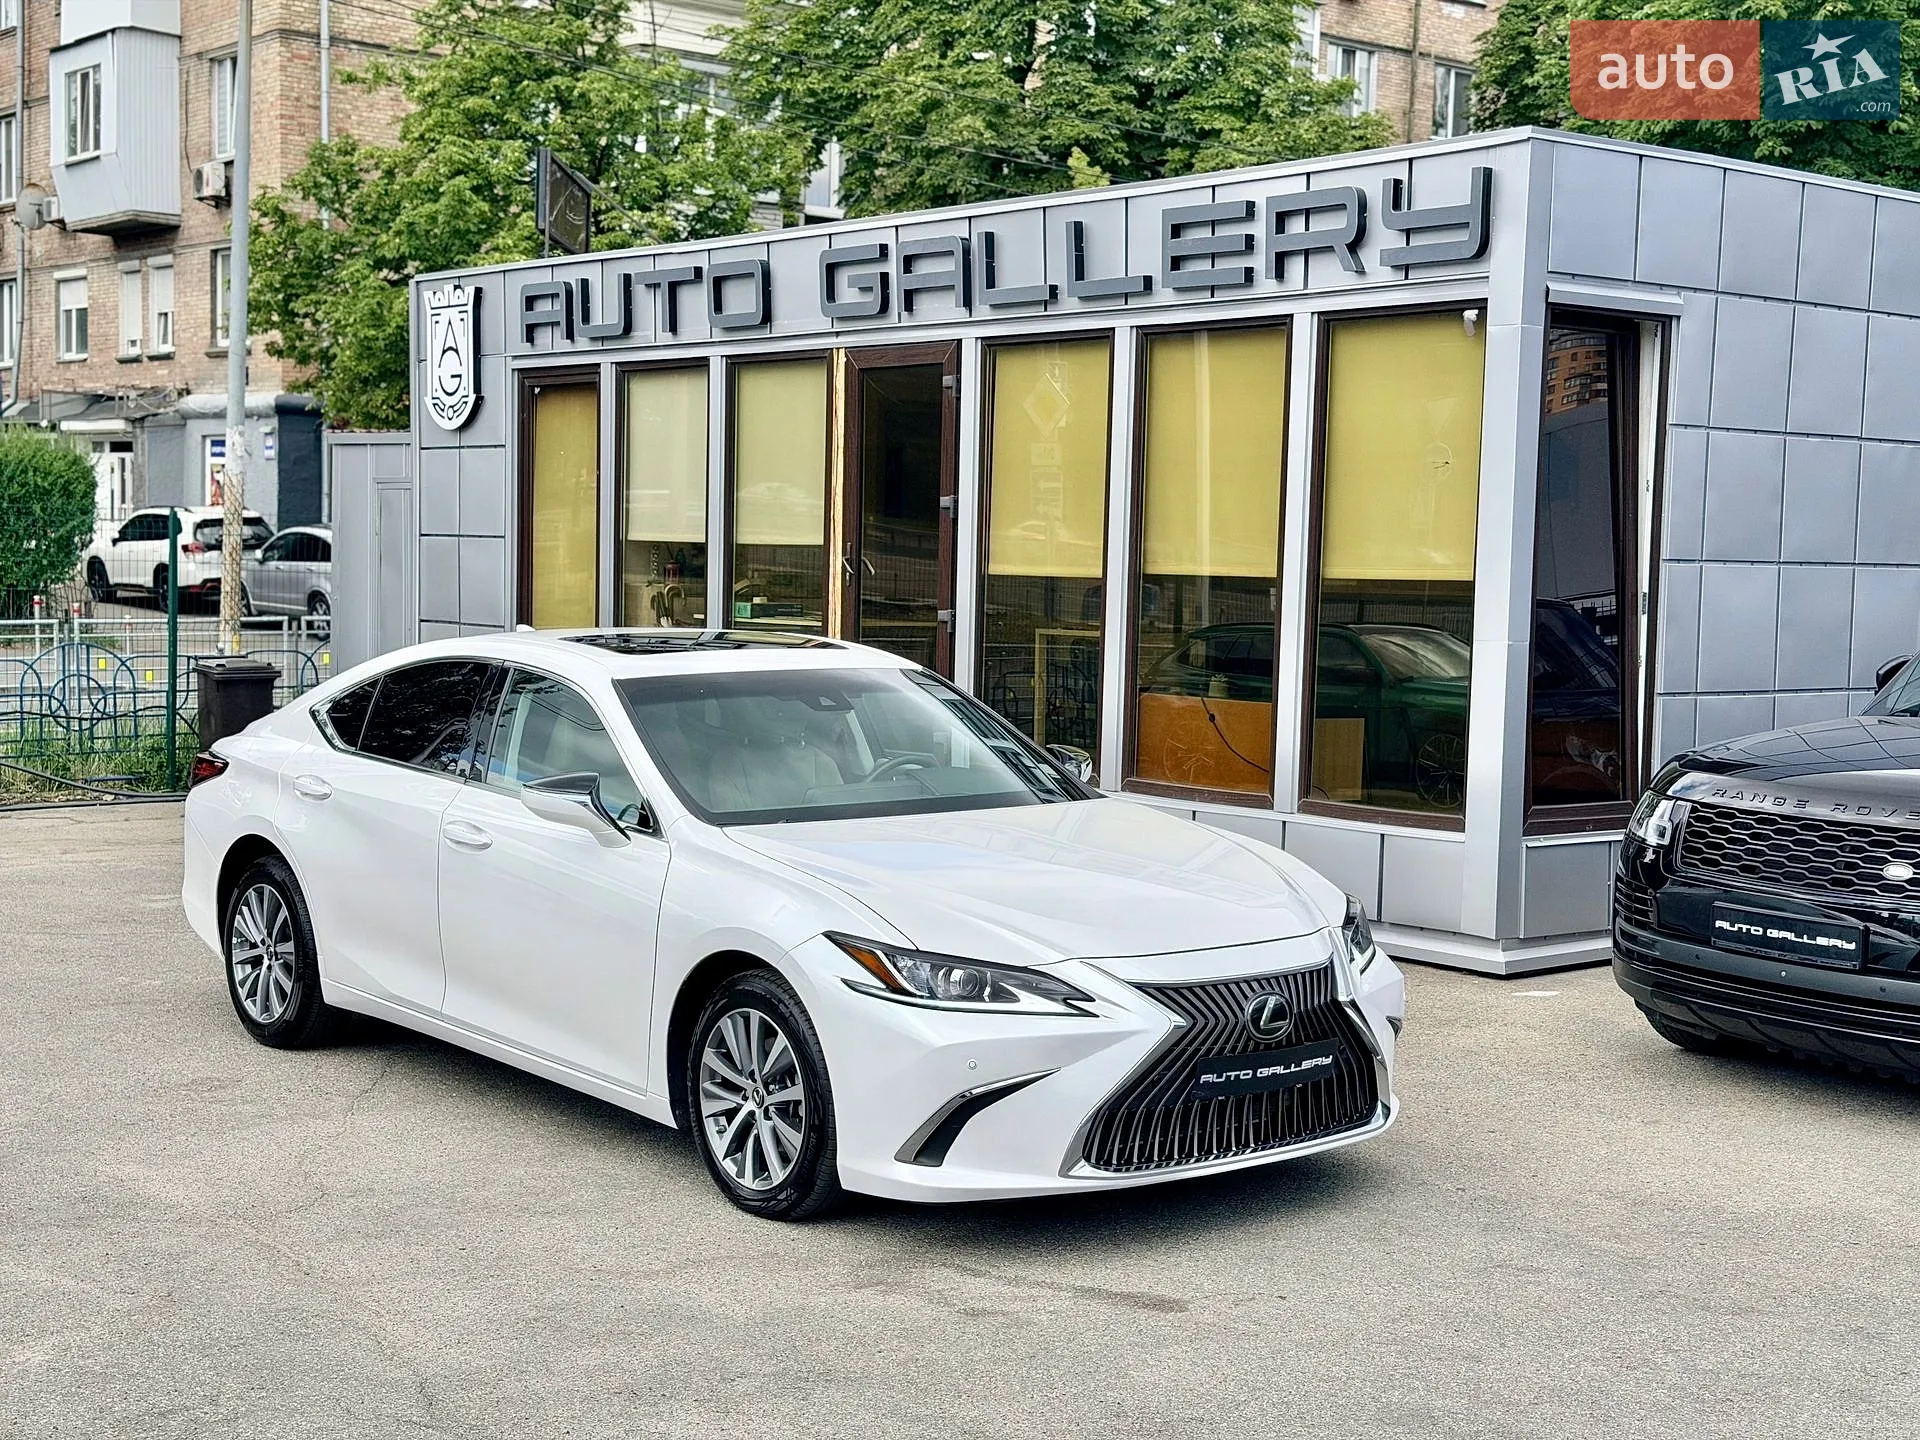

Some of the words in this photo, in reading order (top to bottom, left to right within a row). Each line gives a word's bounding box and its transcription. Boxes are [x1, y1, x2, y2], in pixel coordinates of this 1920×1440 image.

[520, 258, 770, 344] AUTO
[819, 166, 1493, 319] GALLERY
[1711, 787, 1810, 809] RANGE
[1714, 920, 1763, 936] AUTO
[1766, 927, 1857, 951] GALLERY
[1200, 1069, 1253, 1084] AUTO
[1256, 1054, 1333, 1078] GALLERY
